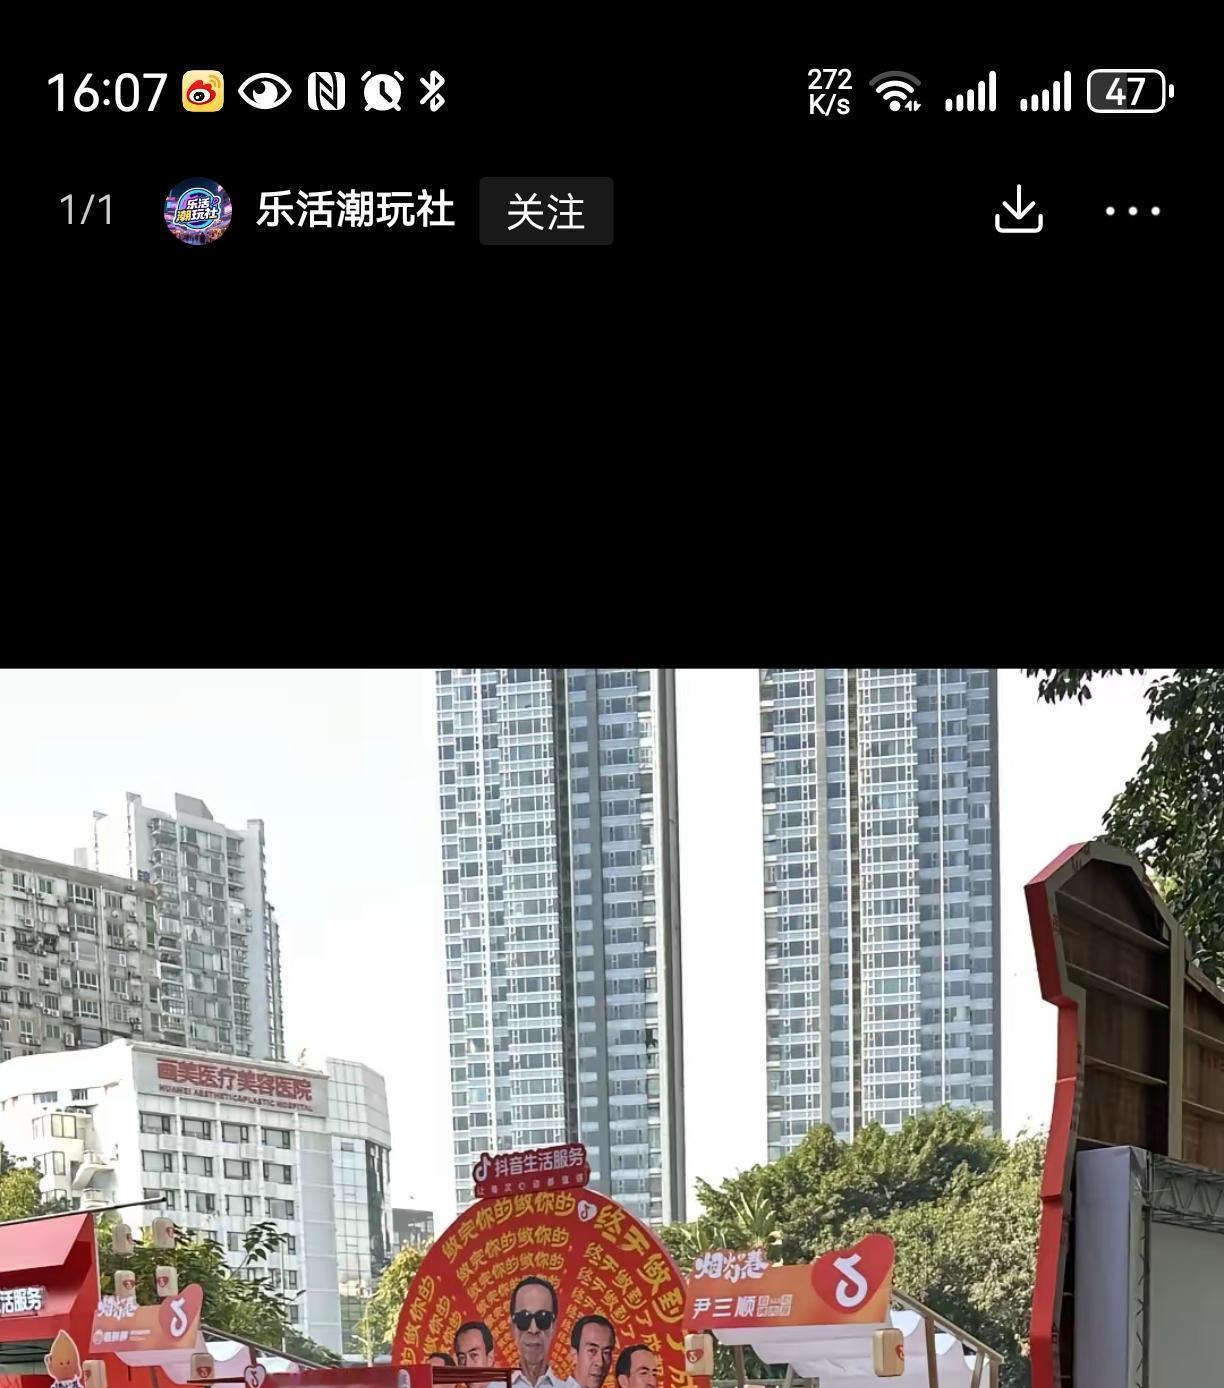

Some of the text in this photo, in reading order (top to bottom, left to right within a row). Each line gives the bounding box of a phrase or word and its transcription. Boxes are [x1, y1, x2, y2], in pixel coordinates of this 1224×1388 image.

[494, 1147, 584, 1178] 抖音生活服务
[692, 1295, 756, 1320] 尹三顺
